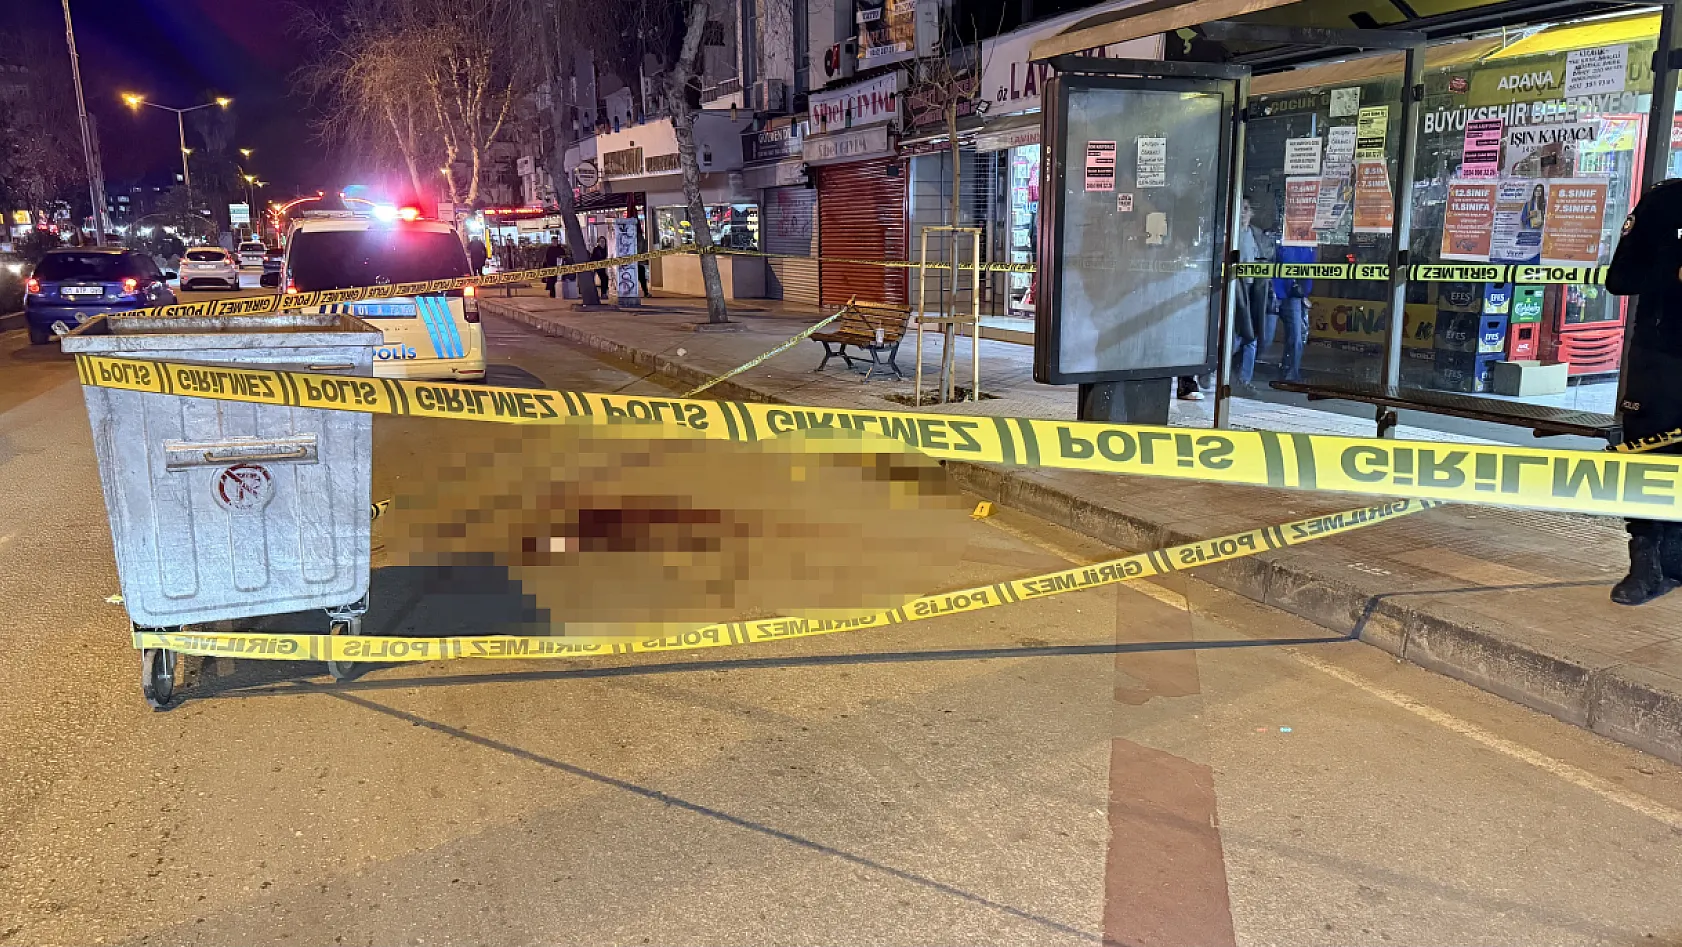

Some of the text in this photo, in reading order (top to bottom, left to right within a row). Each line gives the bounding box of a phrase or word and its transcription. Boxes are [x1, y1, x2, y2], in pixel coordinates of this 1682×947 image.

[1497, 70, 1554, 91] ADANA
[1510, 130, 1535, 148] IŞIN
[1538, 127, 1595, 144] KARACA
[1554, 204, 1597, 213] 7.SINIFA
[1362, 265, 1390, 277] OLİS
[1423, 267, 1498, 280] GİRİLMEZ
[1490, 293, 1505, 302] EFES
